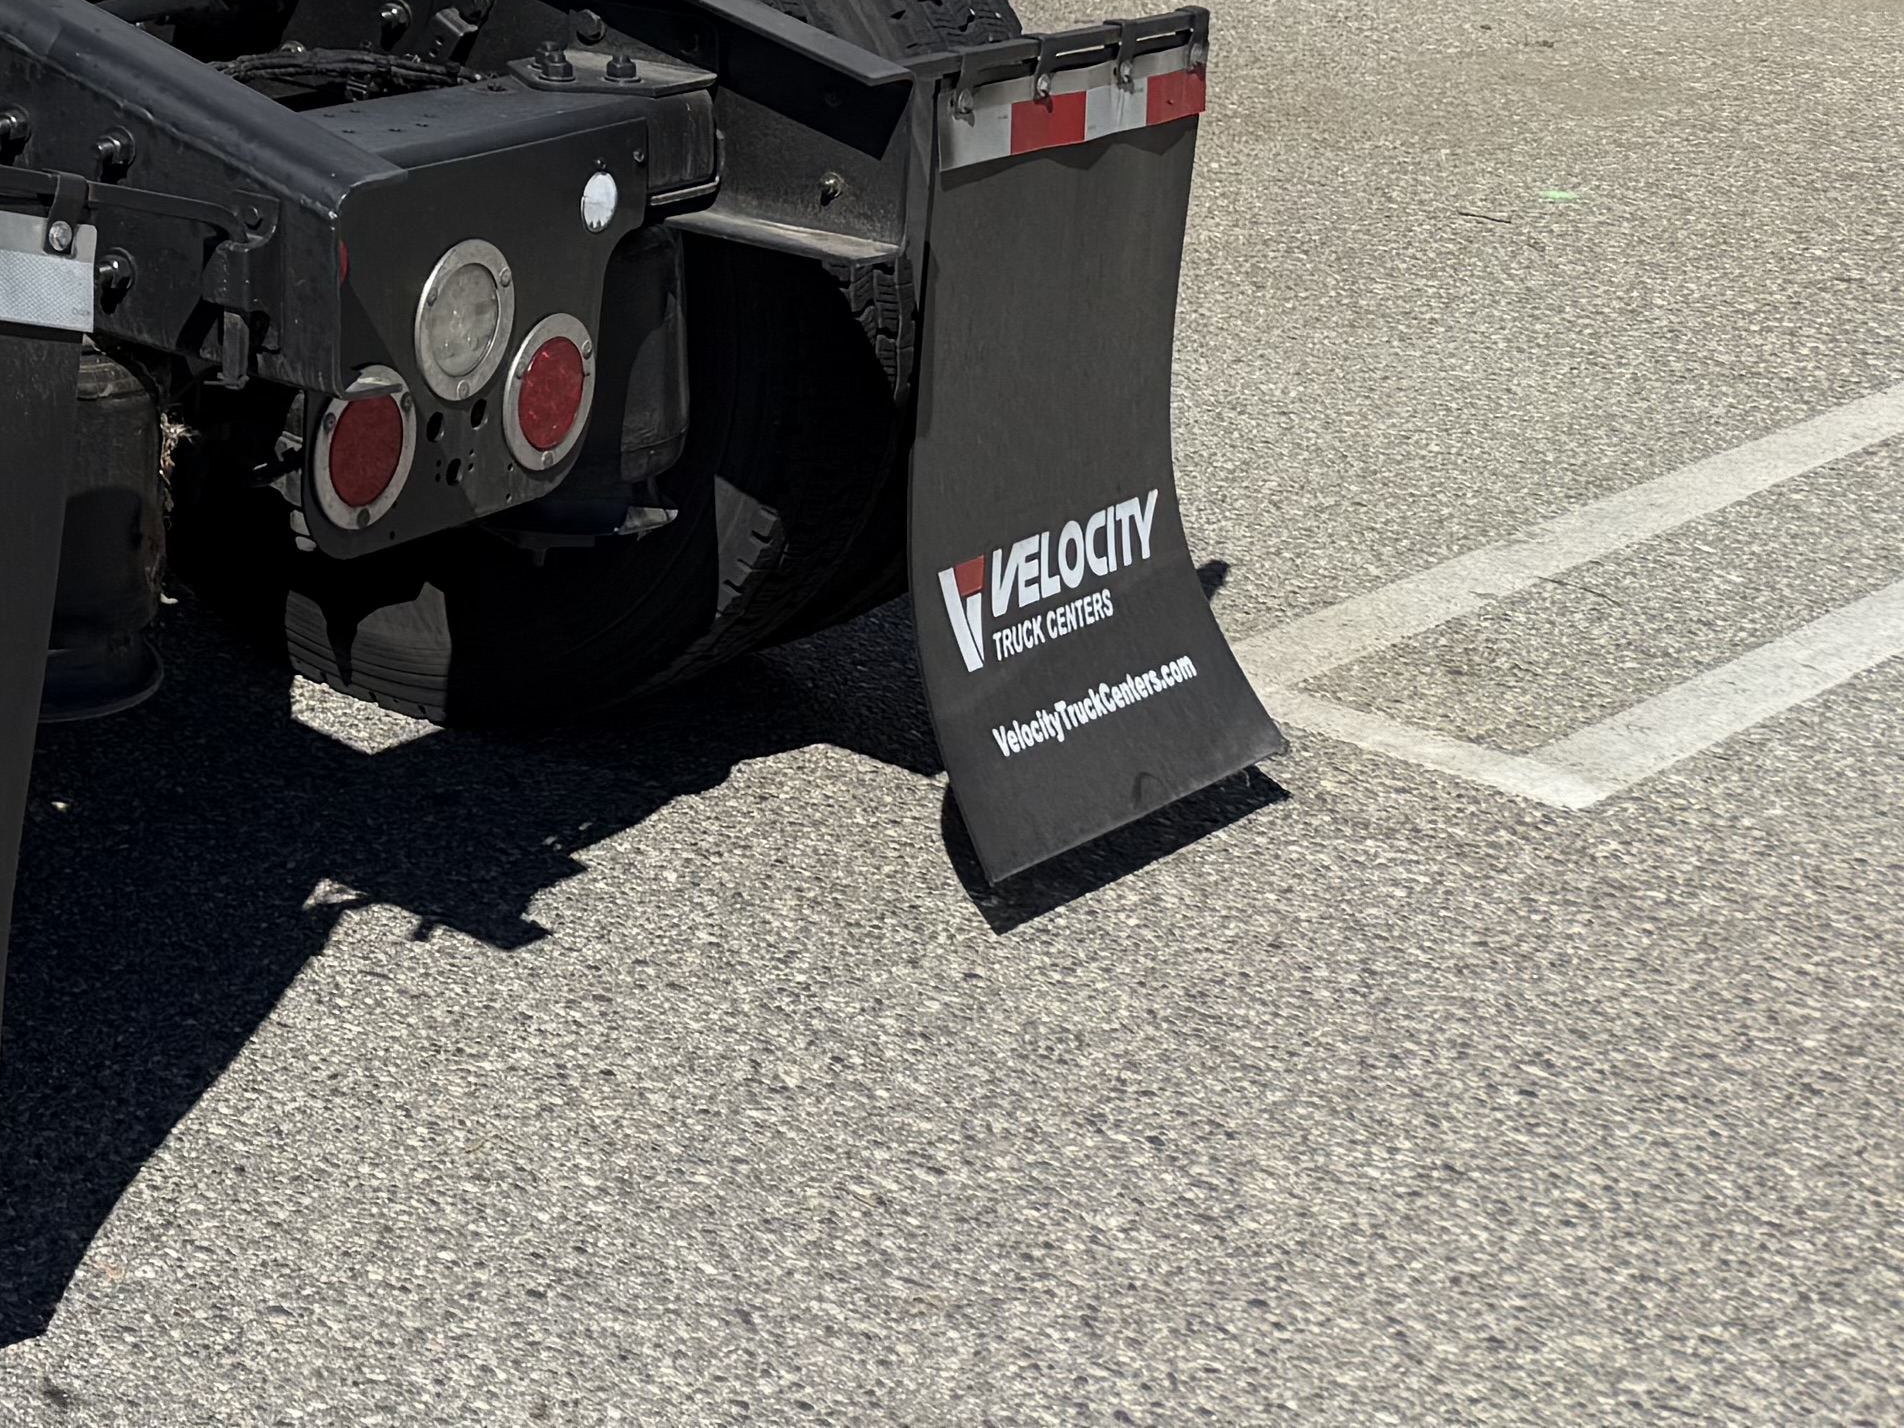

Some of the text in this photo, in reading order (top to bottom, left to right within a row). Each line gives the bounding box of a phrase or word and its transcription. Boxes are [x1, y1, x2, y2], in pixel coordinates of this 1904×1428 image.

[992, 488, 1159, 618] VELOCITY
[993, 589, 1114, 661] TRUCK CENTERS
[992, 654, 1198, 757] VelocityTruckCenters.com
